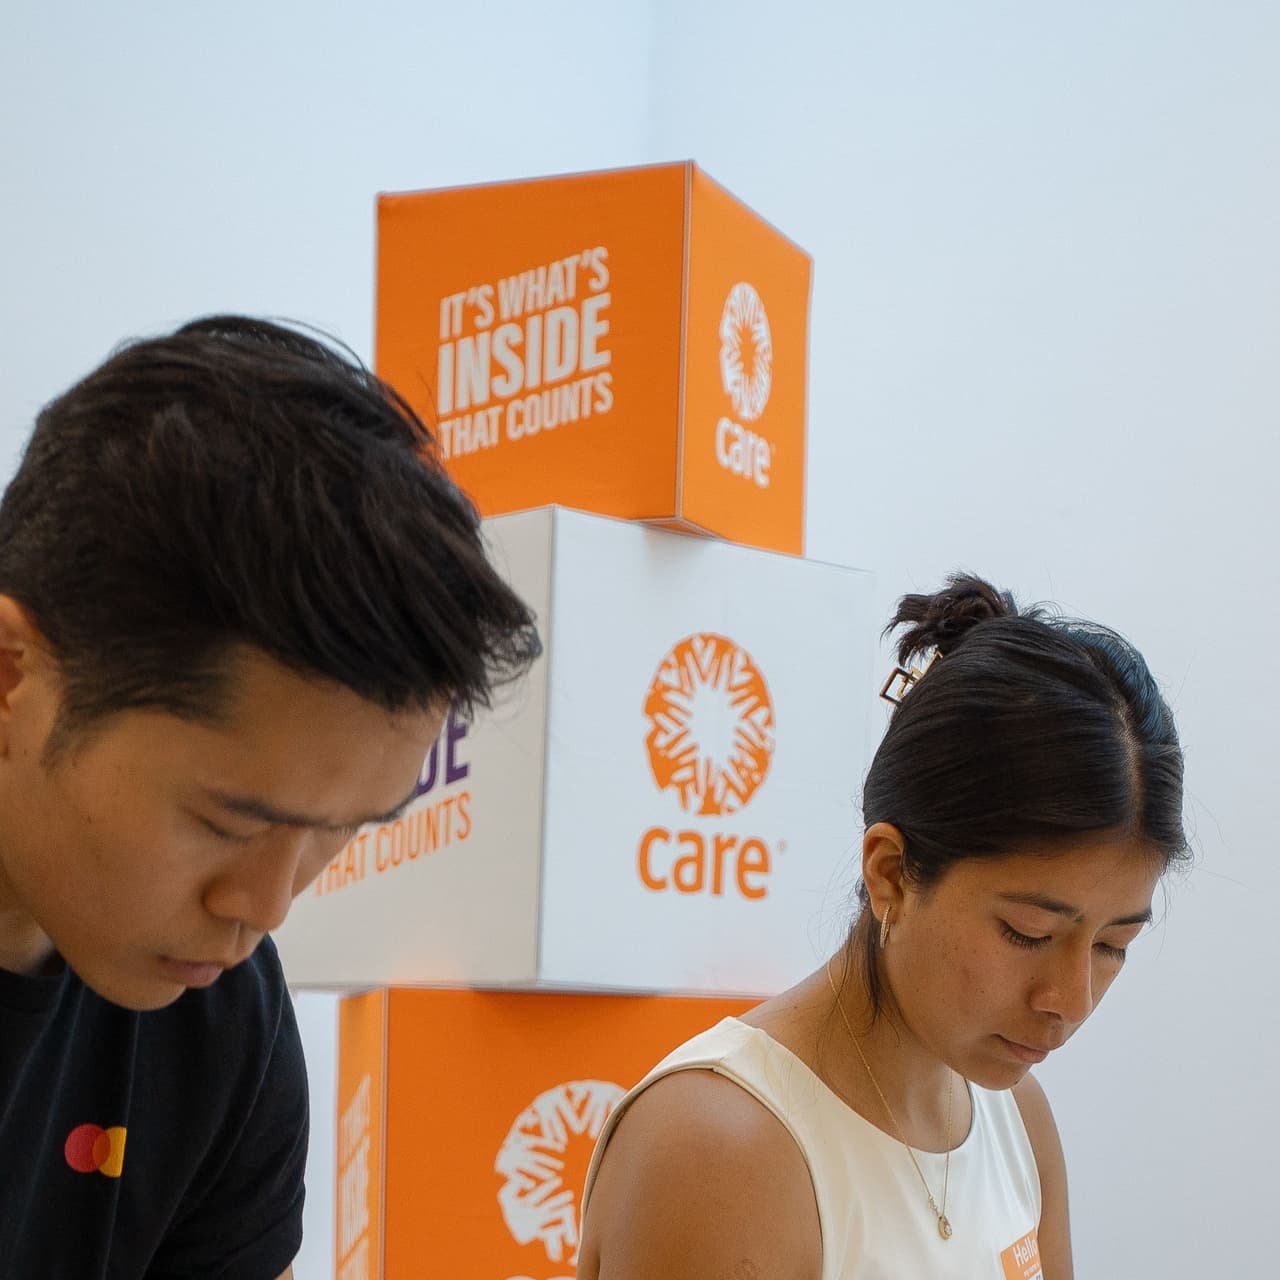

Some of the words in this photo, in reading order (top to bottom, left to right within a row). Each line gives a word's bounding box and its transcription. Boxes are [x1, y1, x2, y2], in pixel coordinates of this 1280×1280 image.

[438, 283, 495, 340] IT'S
[497, 246, 609, 321] WHAT'S
[438, 292, 611, 416] INSIDE
[439, 404, 503, 461] THAT
[505, 371, 613, 441] COUNTS
[715, 416, 771, 488] care
[316, 832, 370, 897] HAT
[374, 789, 472, 874] COUNTS
[637, 825, 771, 900] care
